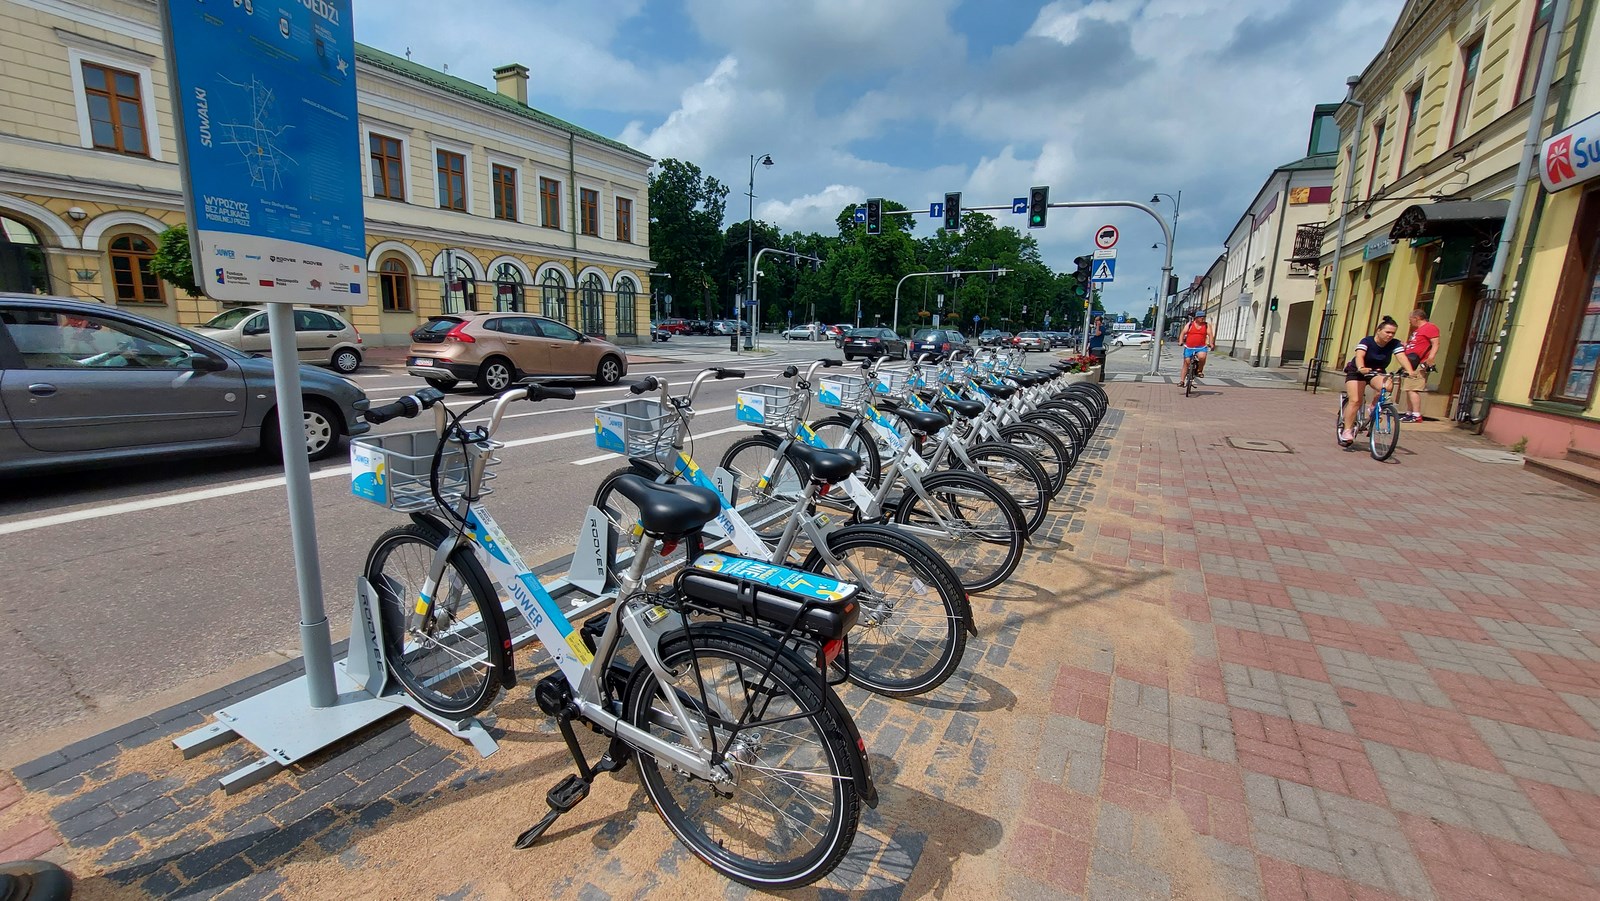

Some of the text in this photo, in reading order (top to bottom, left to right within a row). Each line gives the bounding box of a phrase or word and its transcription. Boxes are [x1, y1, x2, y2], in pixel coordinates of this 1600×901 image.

[194, 86, 213, 148] SUWAŁKI
[203, 194, 249, 212] WYPOŻYCZ
[205, 204, 250, 220] BEZ APLIKACJI
[205, 213, 251, 227] MOBILNEJ PRZEZ
[590, 518, 605, 577] ROOVEE
[361, 594, 385, 673] ROOVEE
